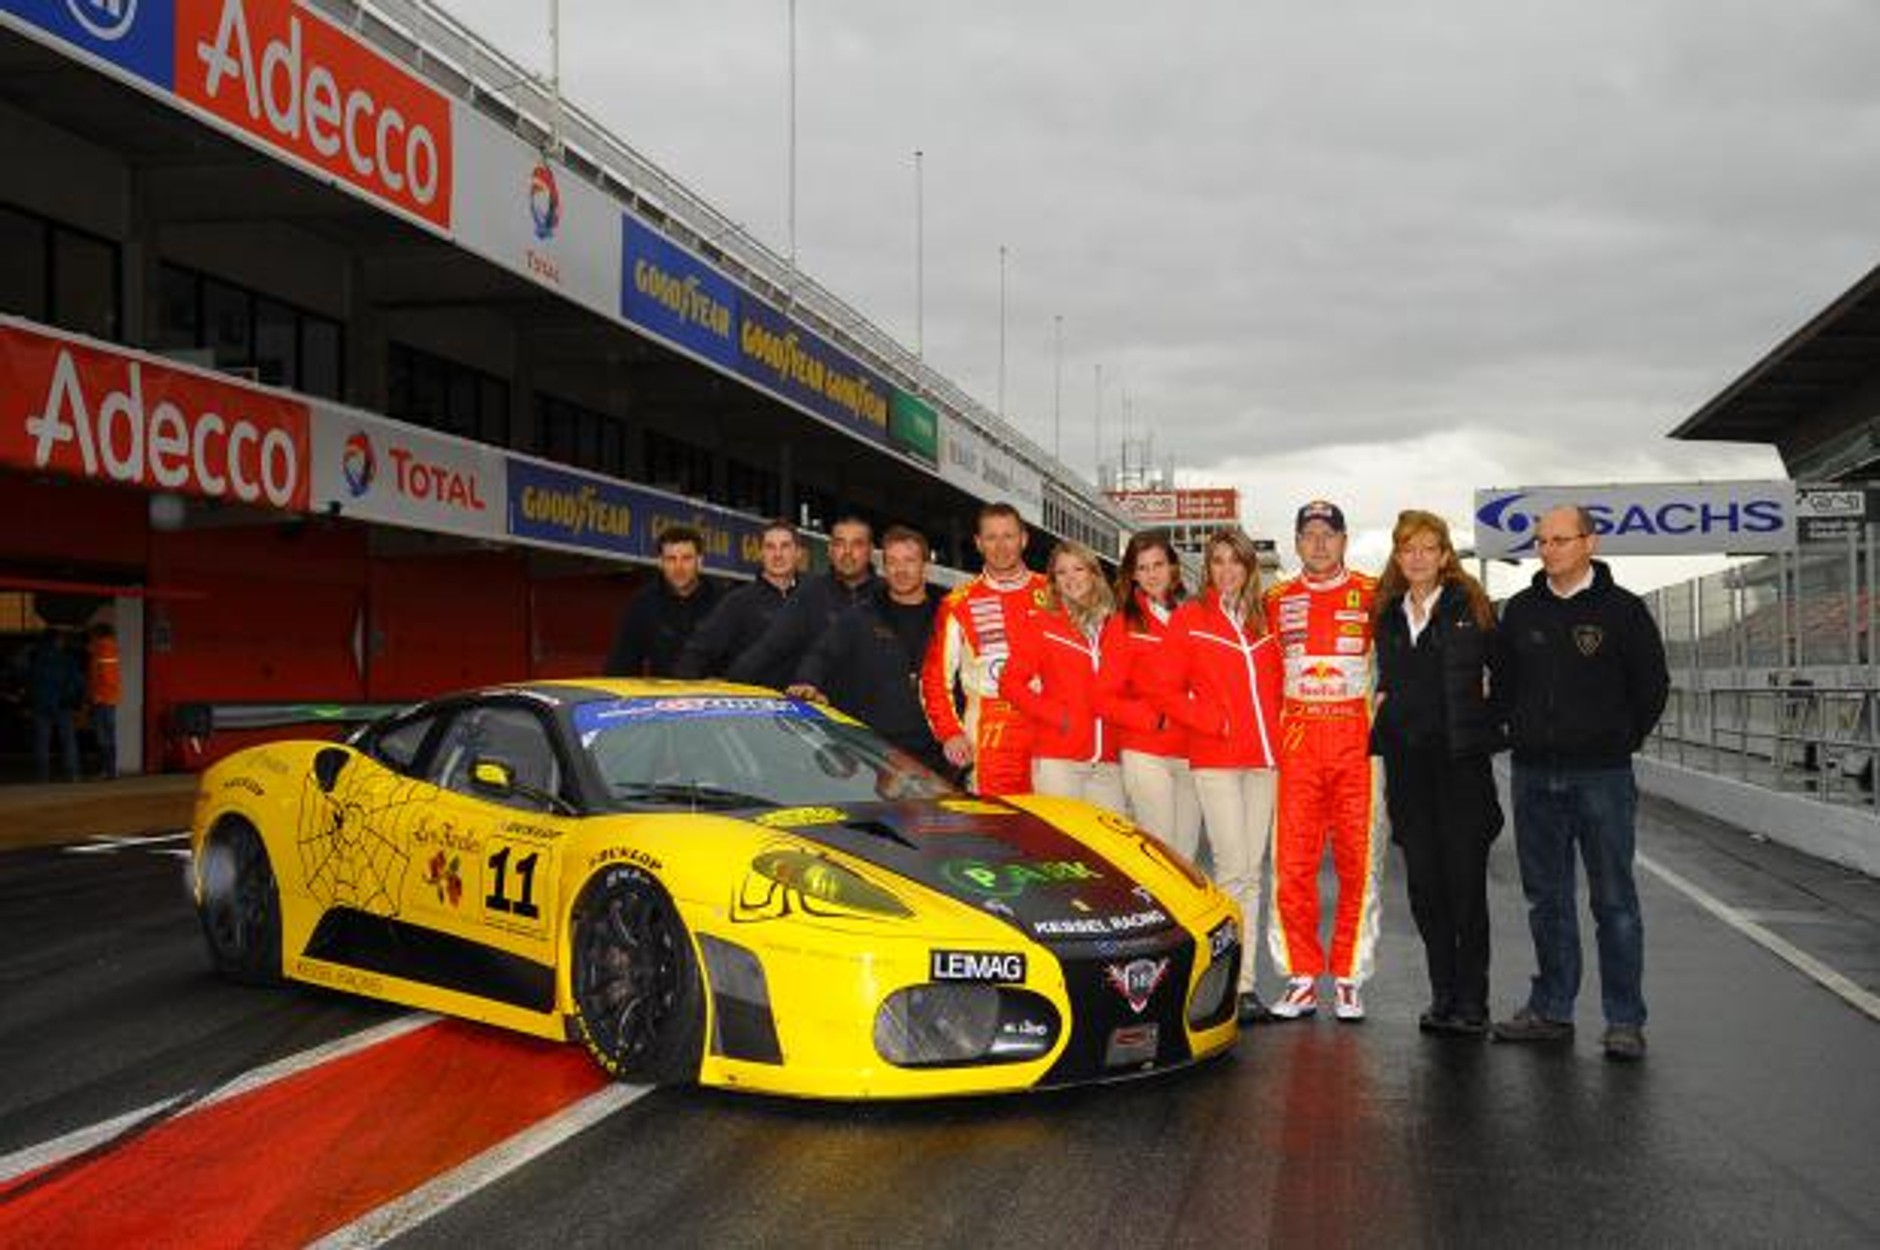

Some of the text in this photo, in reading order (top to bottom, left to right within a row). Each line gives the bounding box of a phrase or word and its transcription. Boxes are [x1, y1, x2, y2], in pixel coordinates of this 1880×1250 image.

[197, 0, 438, 204] Adecco
[634, 256, 730, 340] GOODYEAR
[26, 348, 296, 507] Adecco
[388, 447, 486, 511] TOTAL
[521, 484, 632, 537] GOODYEAR
[1590, 500, 1783, 536] SACHS
[485, 846, 539, 920] 11
